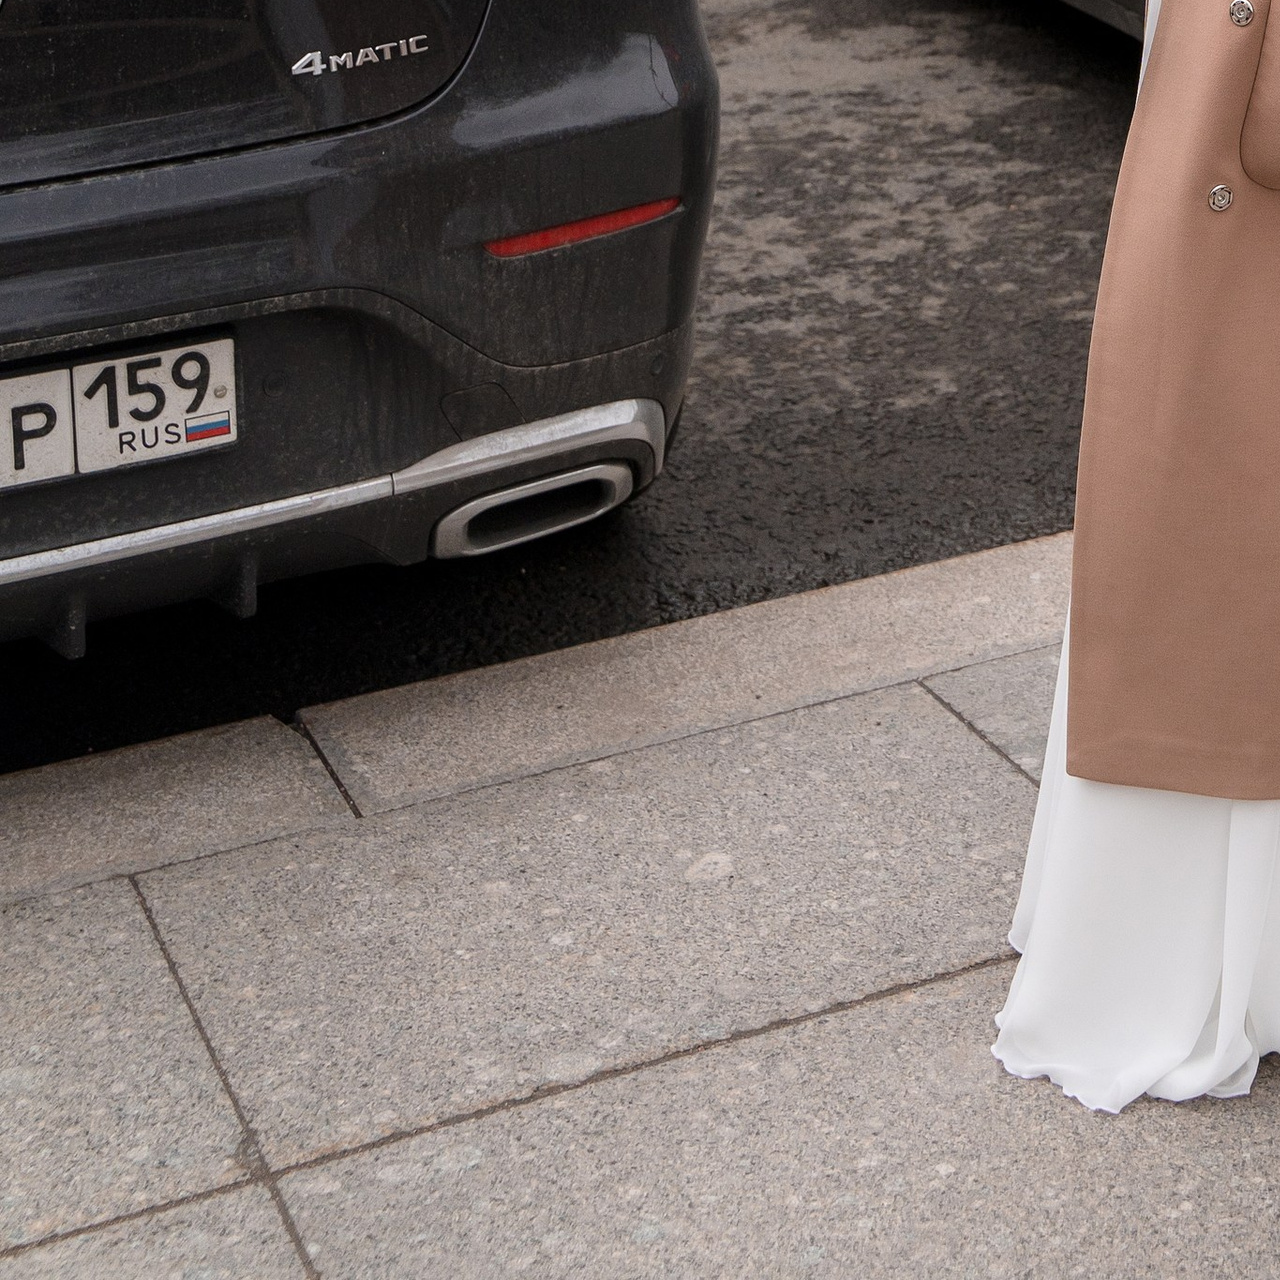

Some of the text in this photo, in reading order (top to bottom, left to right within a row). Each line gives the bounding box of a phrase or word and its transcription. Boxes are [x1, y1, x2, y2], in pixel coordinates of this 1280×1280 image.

[291, 34, 429, 76] 4MATIC
[83, 350, 211, 429] 159
[118, 422, 182, 455] RUS
